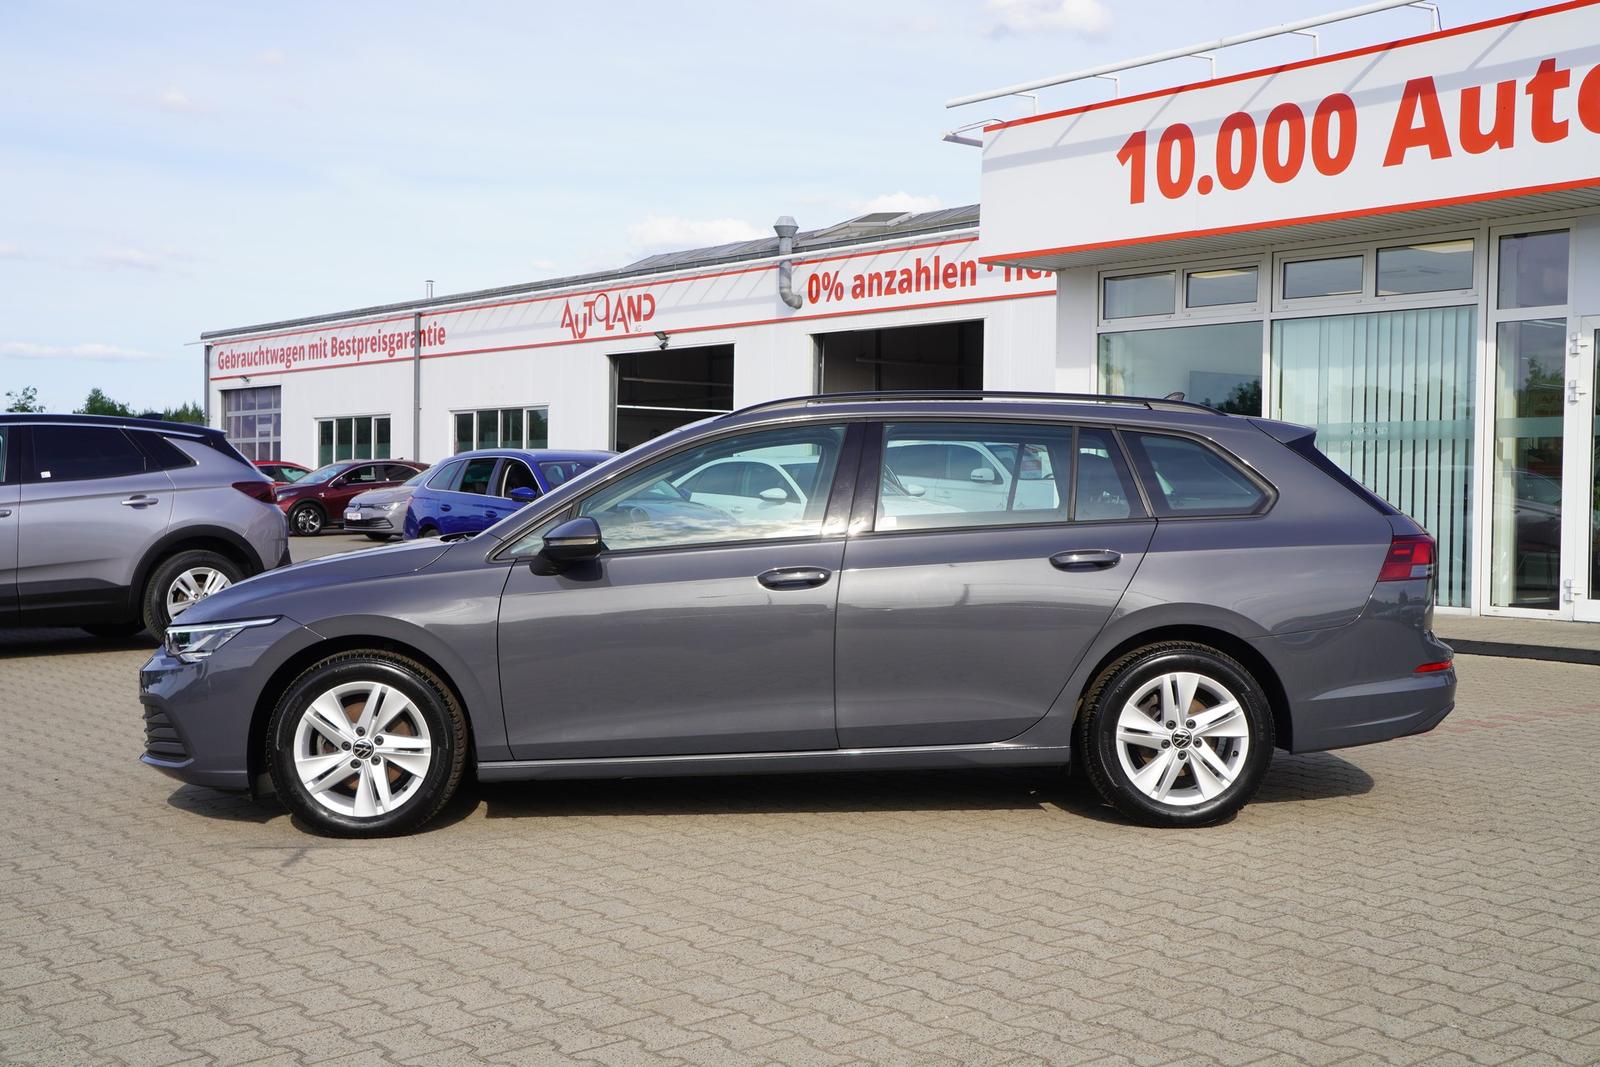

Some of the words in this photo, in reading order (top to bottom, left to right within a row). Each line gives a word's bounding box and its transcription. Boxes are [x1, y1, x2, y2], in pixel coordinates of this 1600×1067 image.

[1116, 93, 1358, 205] 10.000
[807, 271, 845, 304] 0%
[851, 255, 977, 299] anzahlen
[560, 293, 656, 339] AUTOLAND
[218, 345, 305, 370] Gebrauchtwagen
[308, 337, 328, 360] mit
[330, 321, 446, 361] Bestpreisgarantie
